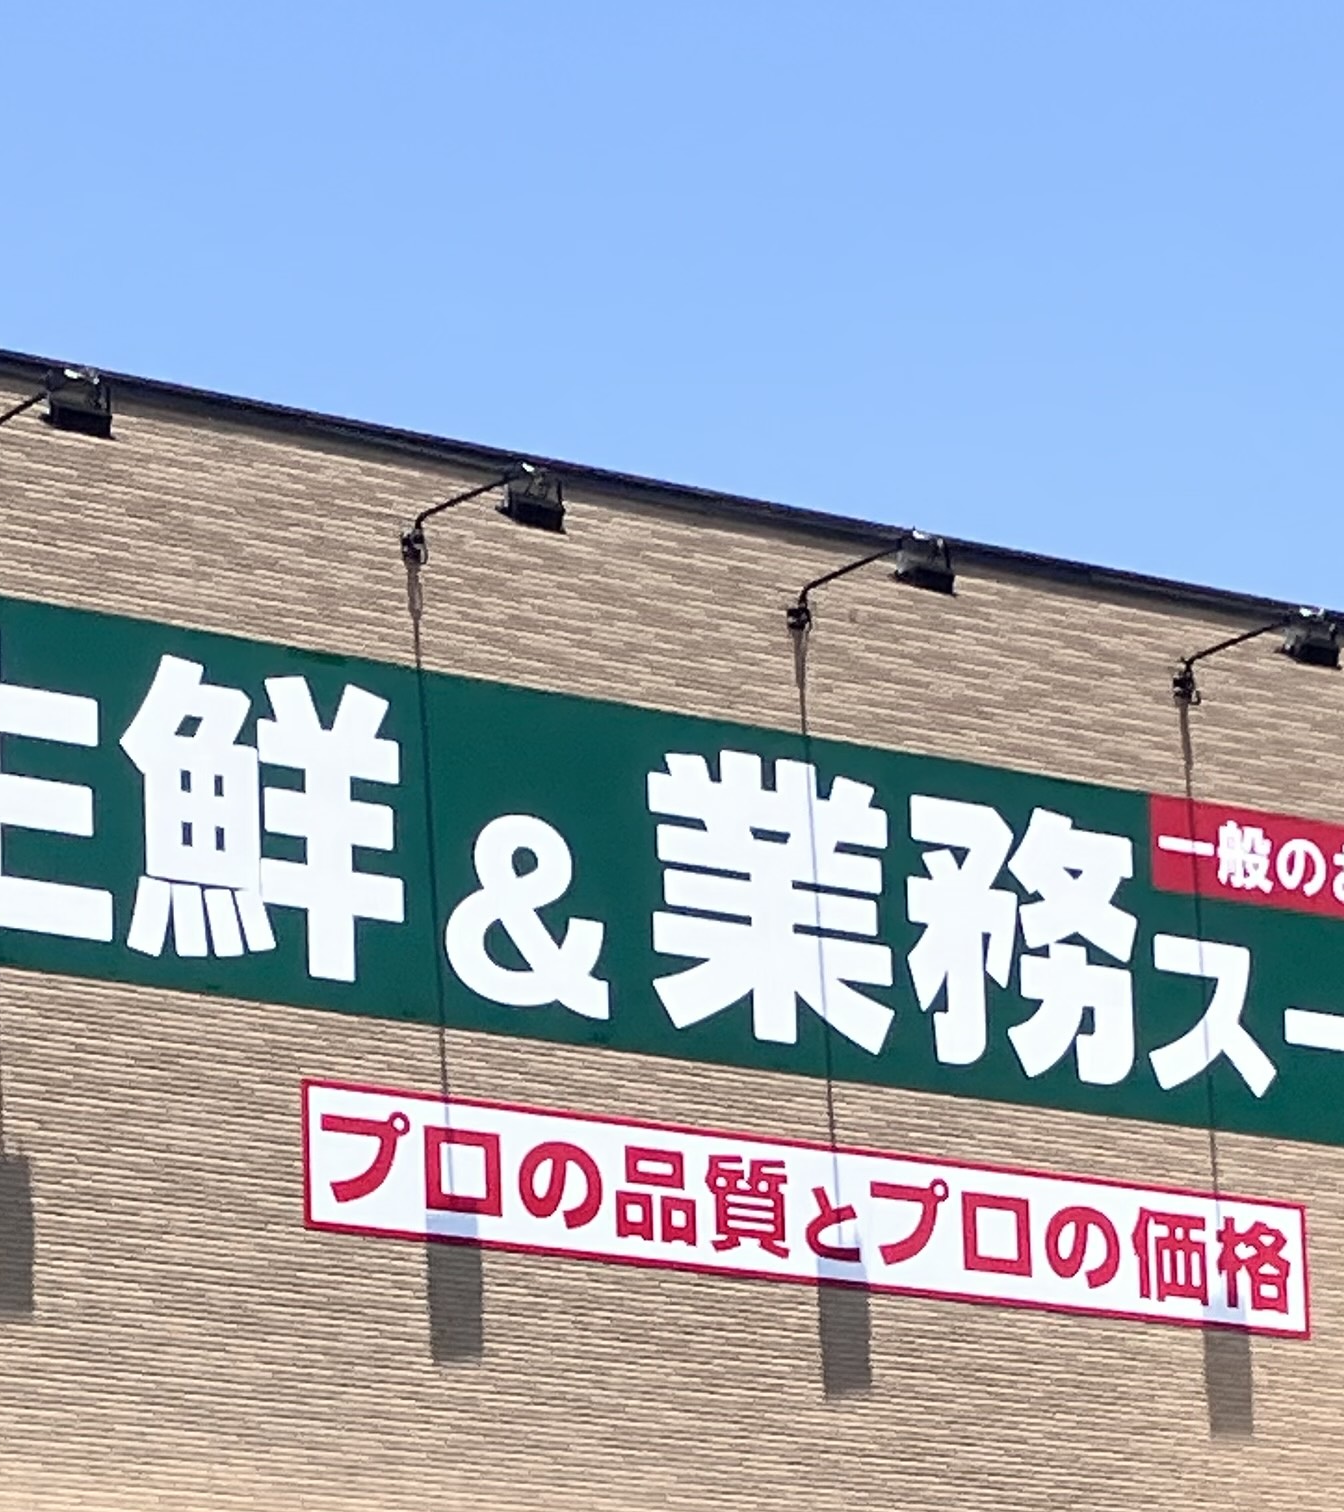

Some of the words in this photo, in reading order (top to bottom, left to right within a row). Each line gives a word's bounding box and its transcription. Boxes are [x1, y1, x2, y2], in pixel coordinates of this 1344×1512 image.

[319, 1111, 1292, 1315] プロの品質とプロの価格
